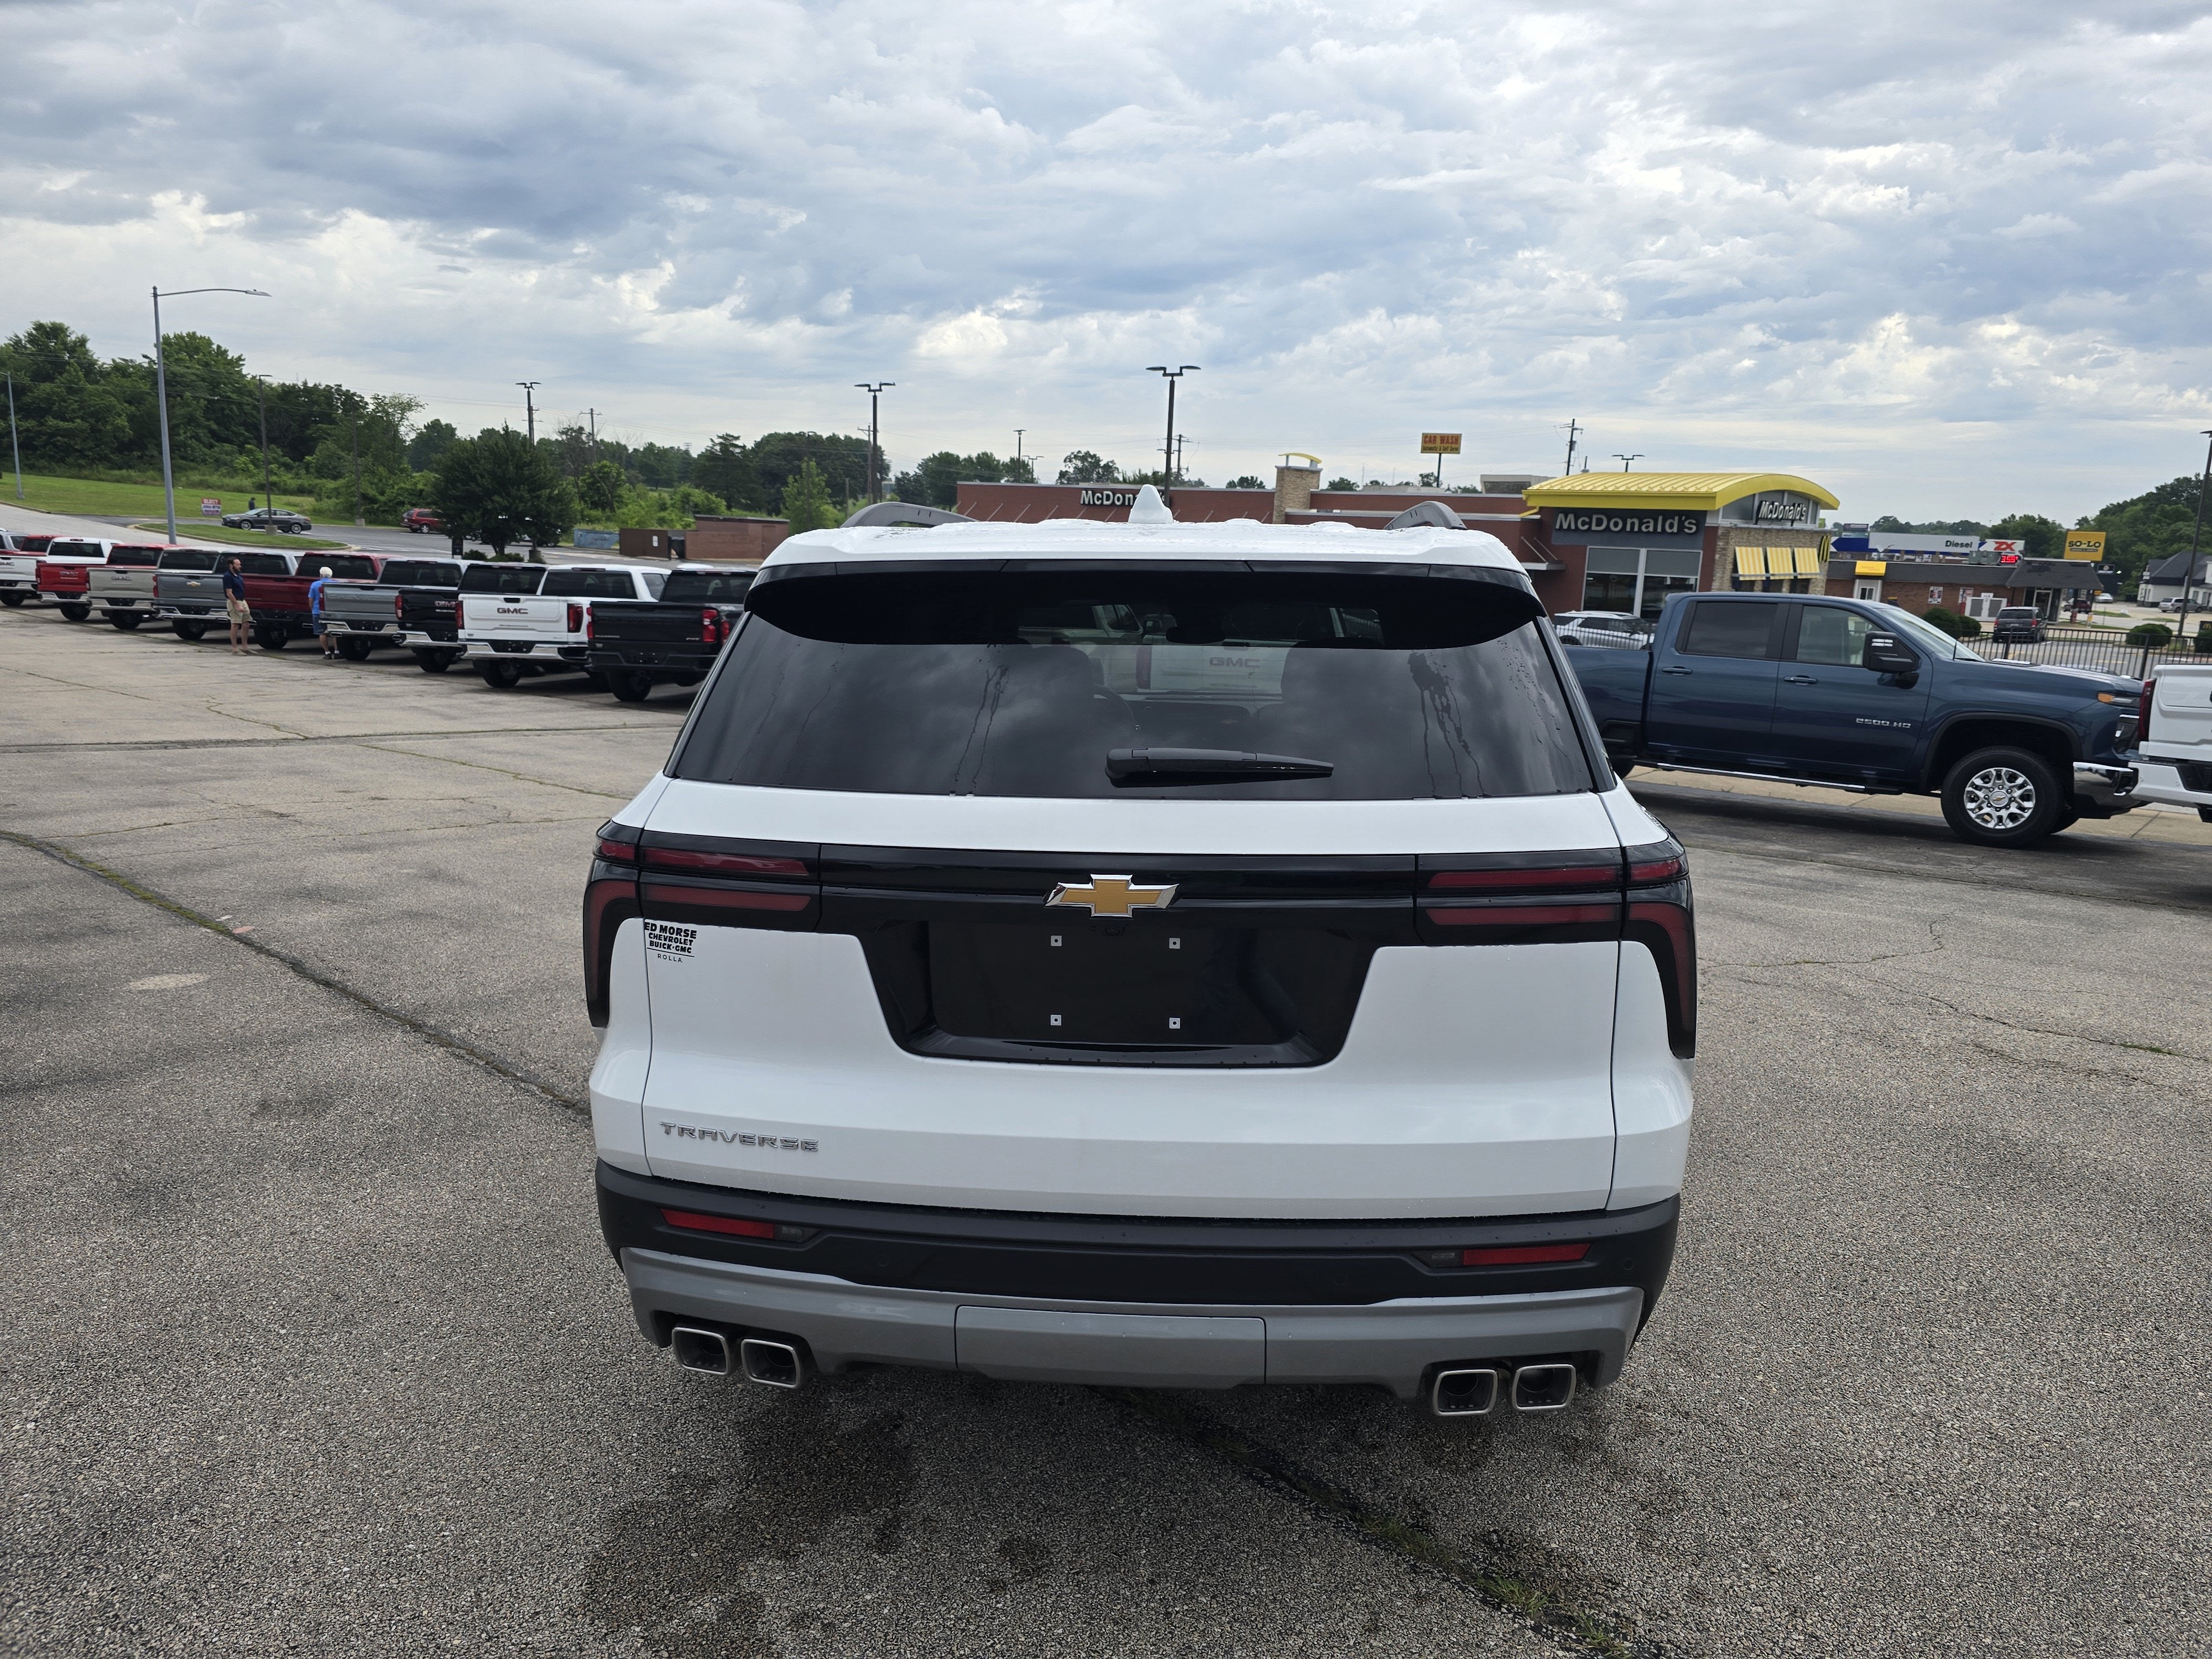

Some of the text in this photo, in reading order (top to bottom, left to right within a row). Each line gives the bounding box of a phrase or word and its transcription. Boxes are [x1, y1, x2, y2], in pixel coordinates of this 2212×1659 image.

[1423, 435, 1459, 445] CAR WASH
[1758, 500, 1806, 520] McDonald's
[1555, 513, 1697, 534] McDonald's
[1945, 540, 1973, 549] Diesel
[1209, 657, 1260, 669] GMC
[1856, 718, 1890, 726] 2500
[644, 921, 697, 939] ED MORSE
[648, 932, 693, 946] CHEVROLET
[658, 953, 683, 963] ROLLA
[659, 1121, 819, 1152] TRAVERSE
